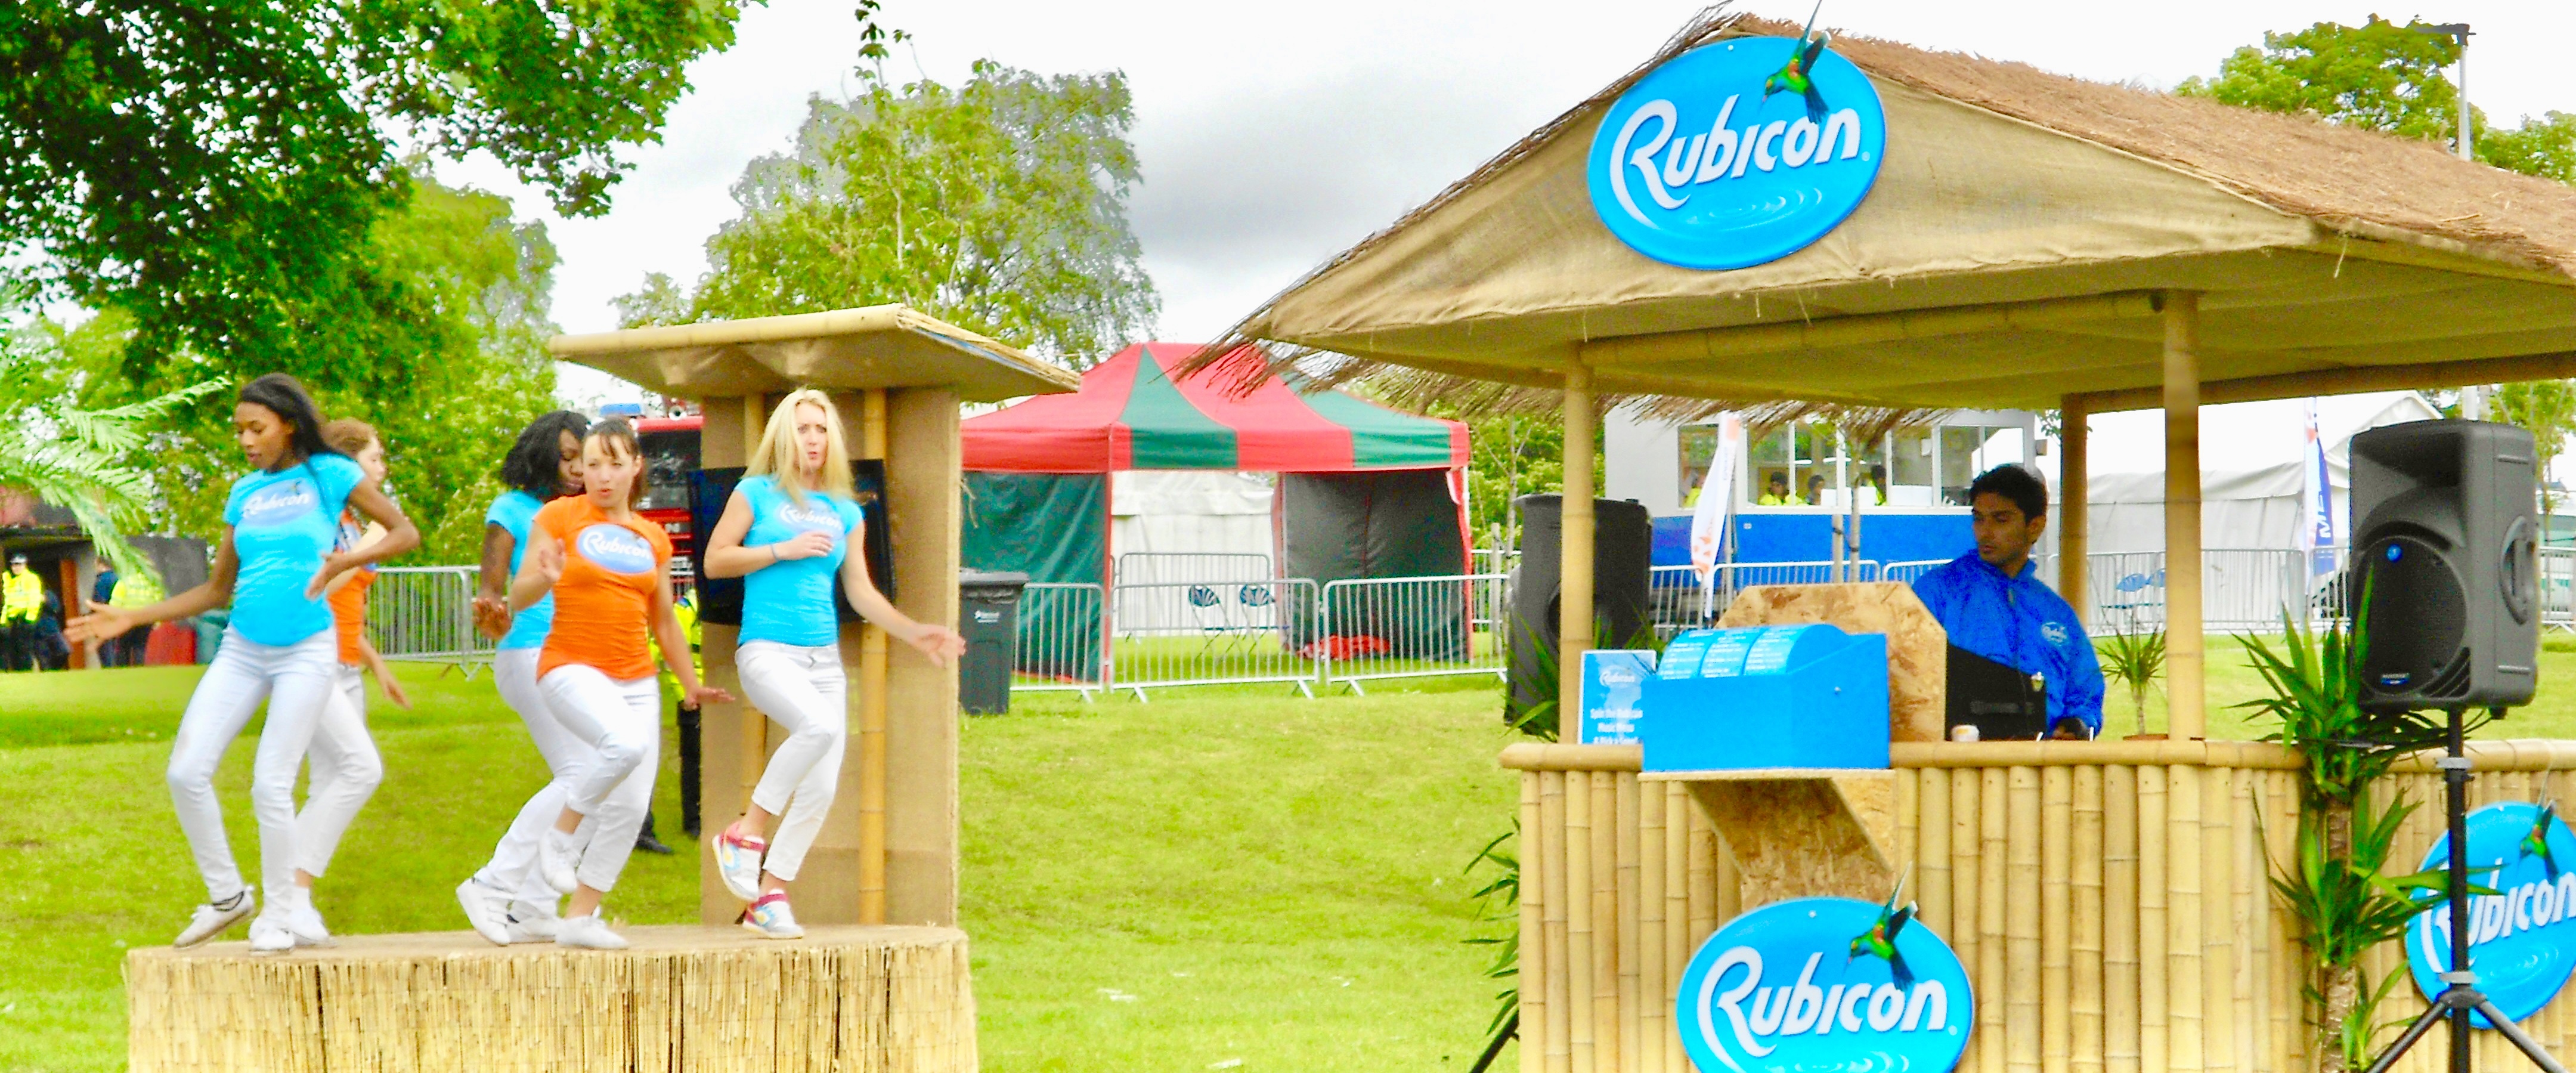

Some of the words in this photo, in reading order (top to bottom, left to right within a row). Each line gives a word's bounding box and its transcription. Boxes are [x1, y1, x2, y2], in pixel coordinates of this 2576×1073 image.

[1609, 93, 1862, 231] Rubicon
[583, 531, 650, 560] Rubicon
[1697, 945, 1948, 1073] Rubicon
